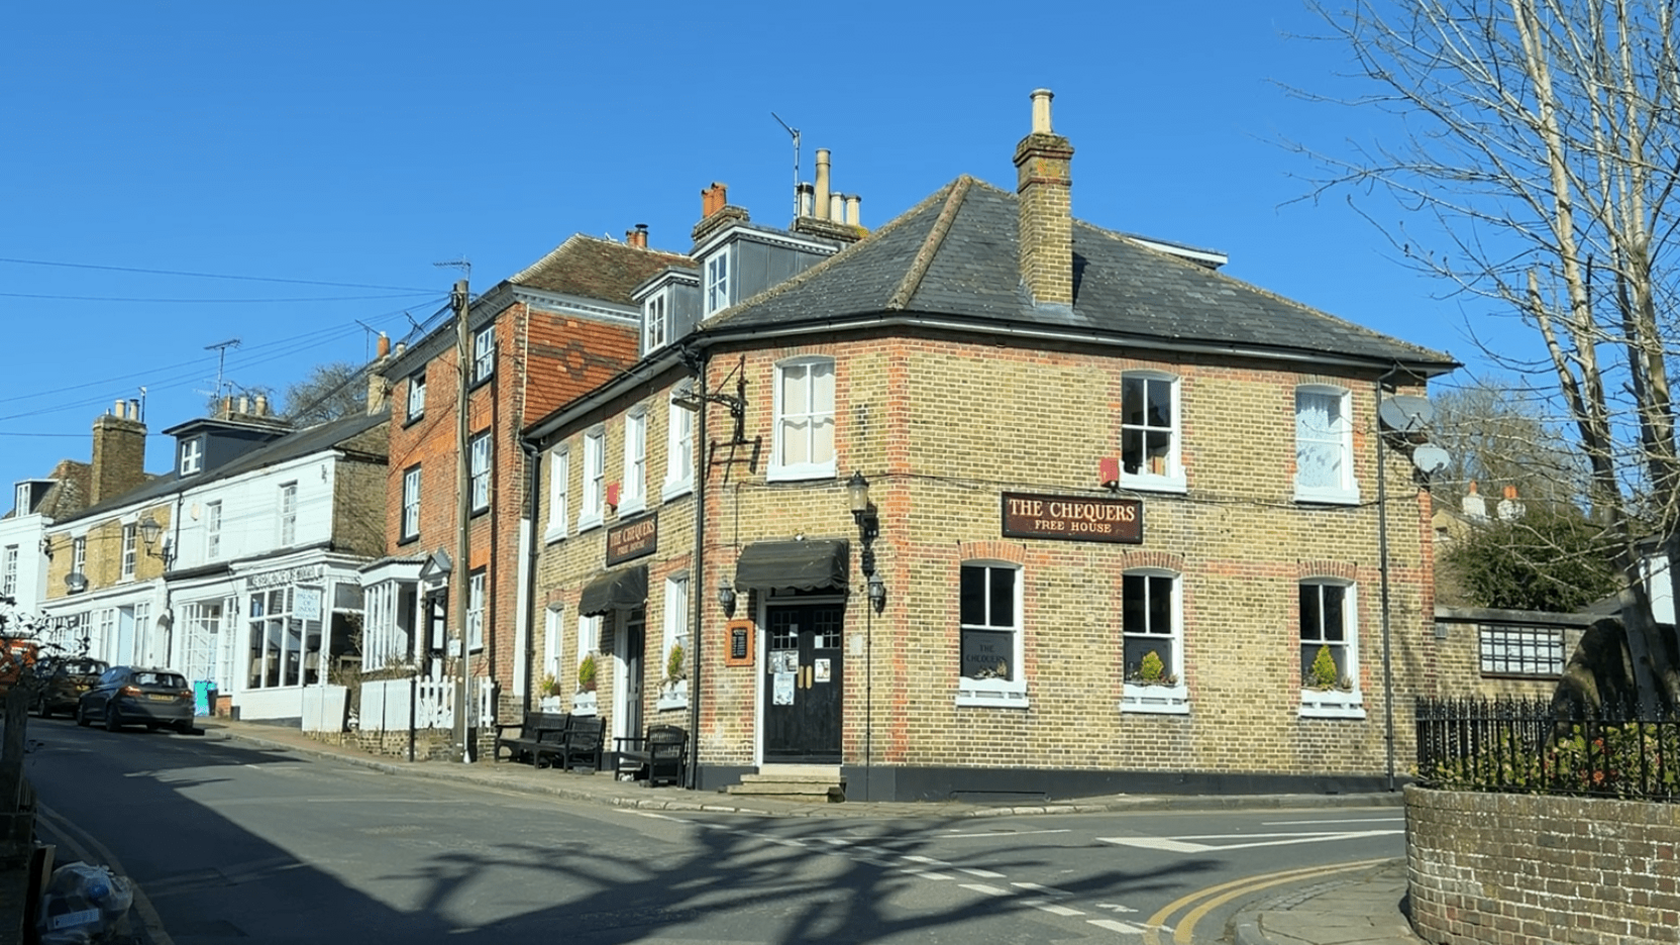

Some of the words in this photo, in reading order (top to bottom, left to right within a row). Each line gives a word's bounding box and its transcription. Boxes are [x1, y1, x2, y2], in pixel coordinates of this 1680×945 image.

[1009, 499, 1043, 517] THE
[1050, 502, 1135, 522] CHEQUERS
[610, 530, 622, 547] THE
[622, 520, 655, 543] CHEQUERS
[1035, 520, 1065, 531] FREE
[1071, 521, 1112, 533] HOUSE
[980, 644, 994, 652] THE
